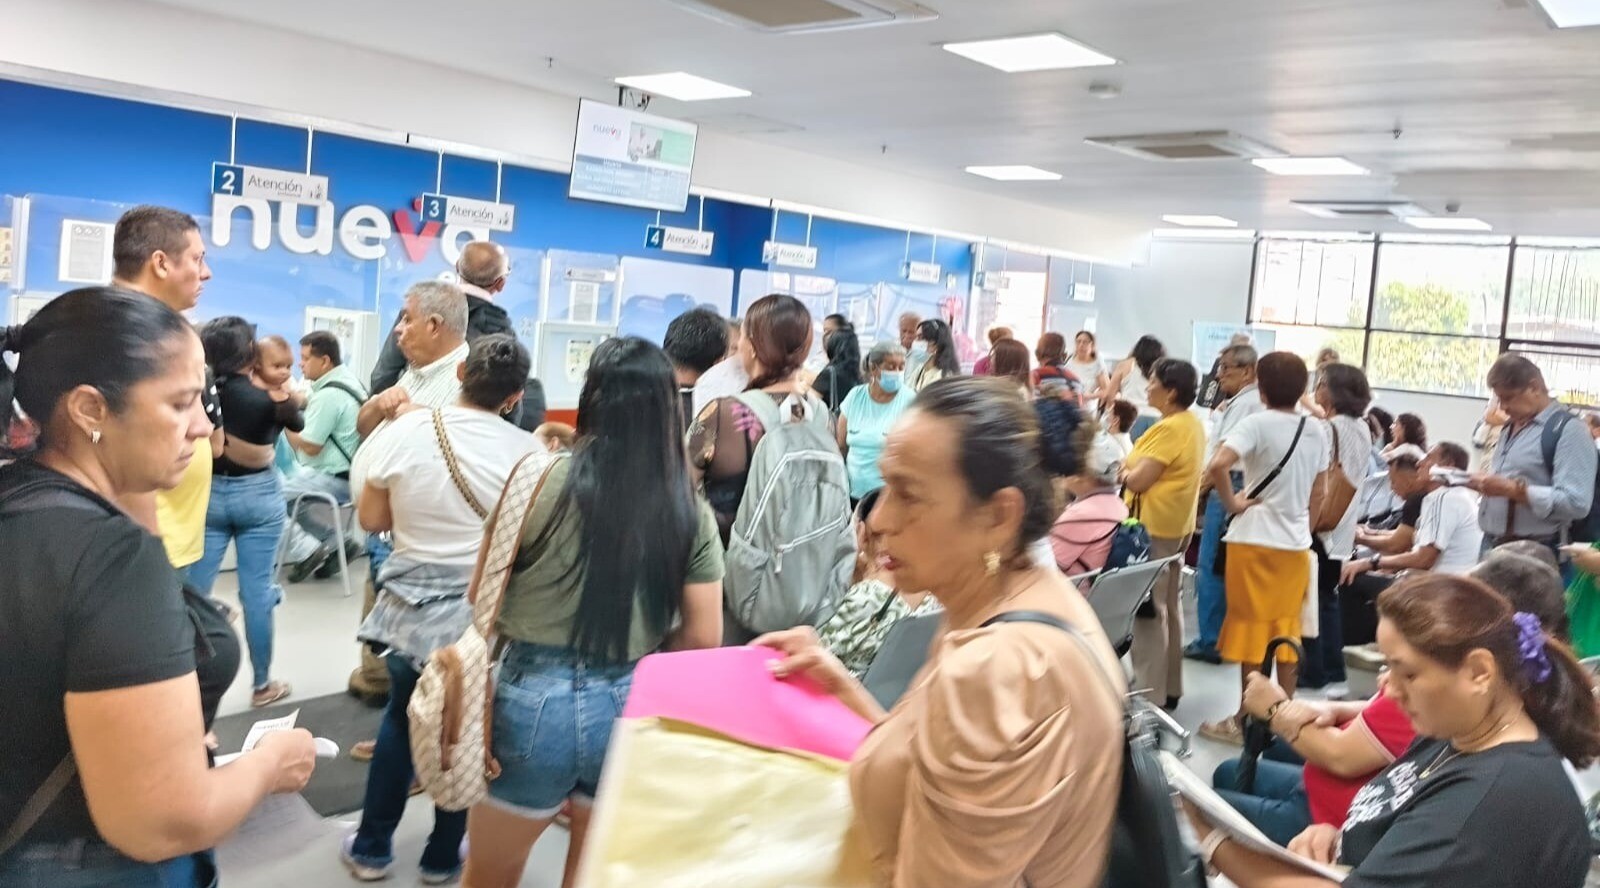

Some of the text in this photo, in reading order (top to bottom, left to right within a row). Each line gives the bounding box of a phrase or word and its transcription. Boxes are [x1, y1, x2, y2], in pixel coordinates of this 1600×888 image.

[221, 170, 303, 192] 2 Atención
[429, 201, 494, 221] 3 Atención
[211, 193, 490, 264] nueva
[650, 230, 660, 246] 4
